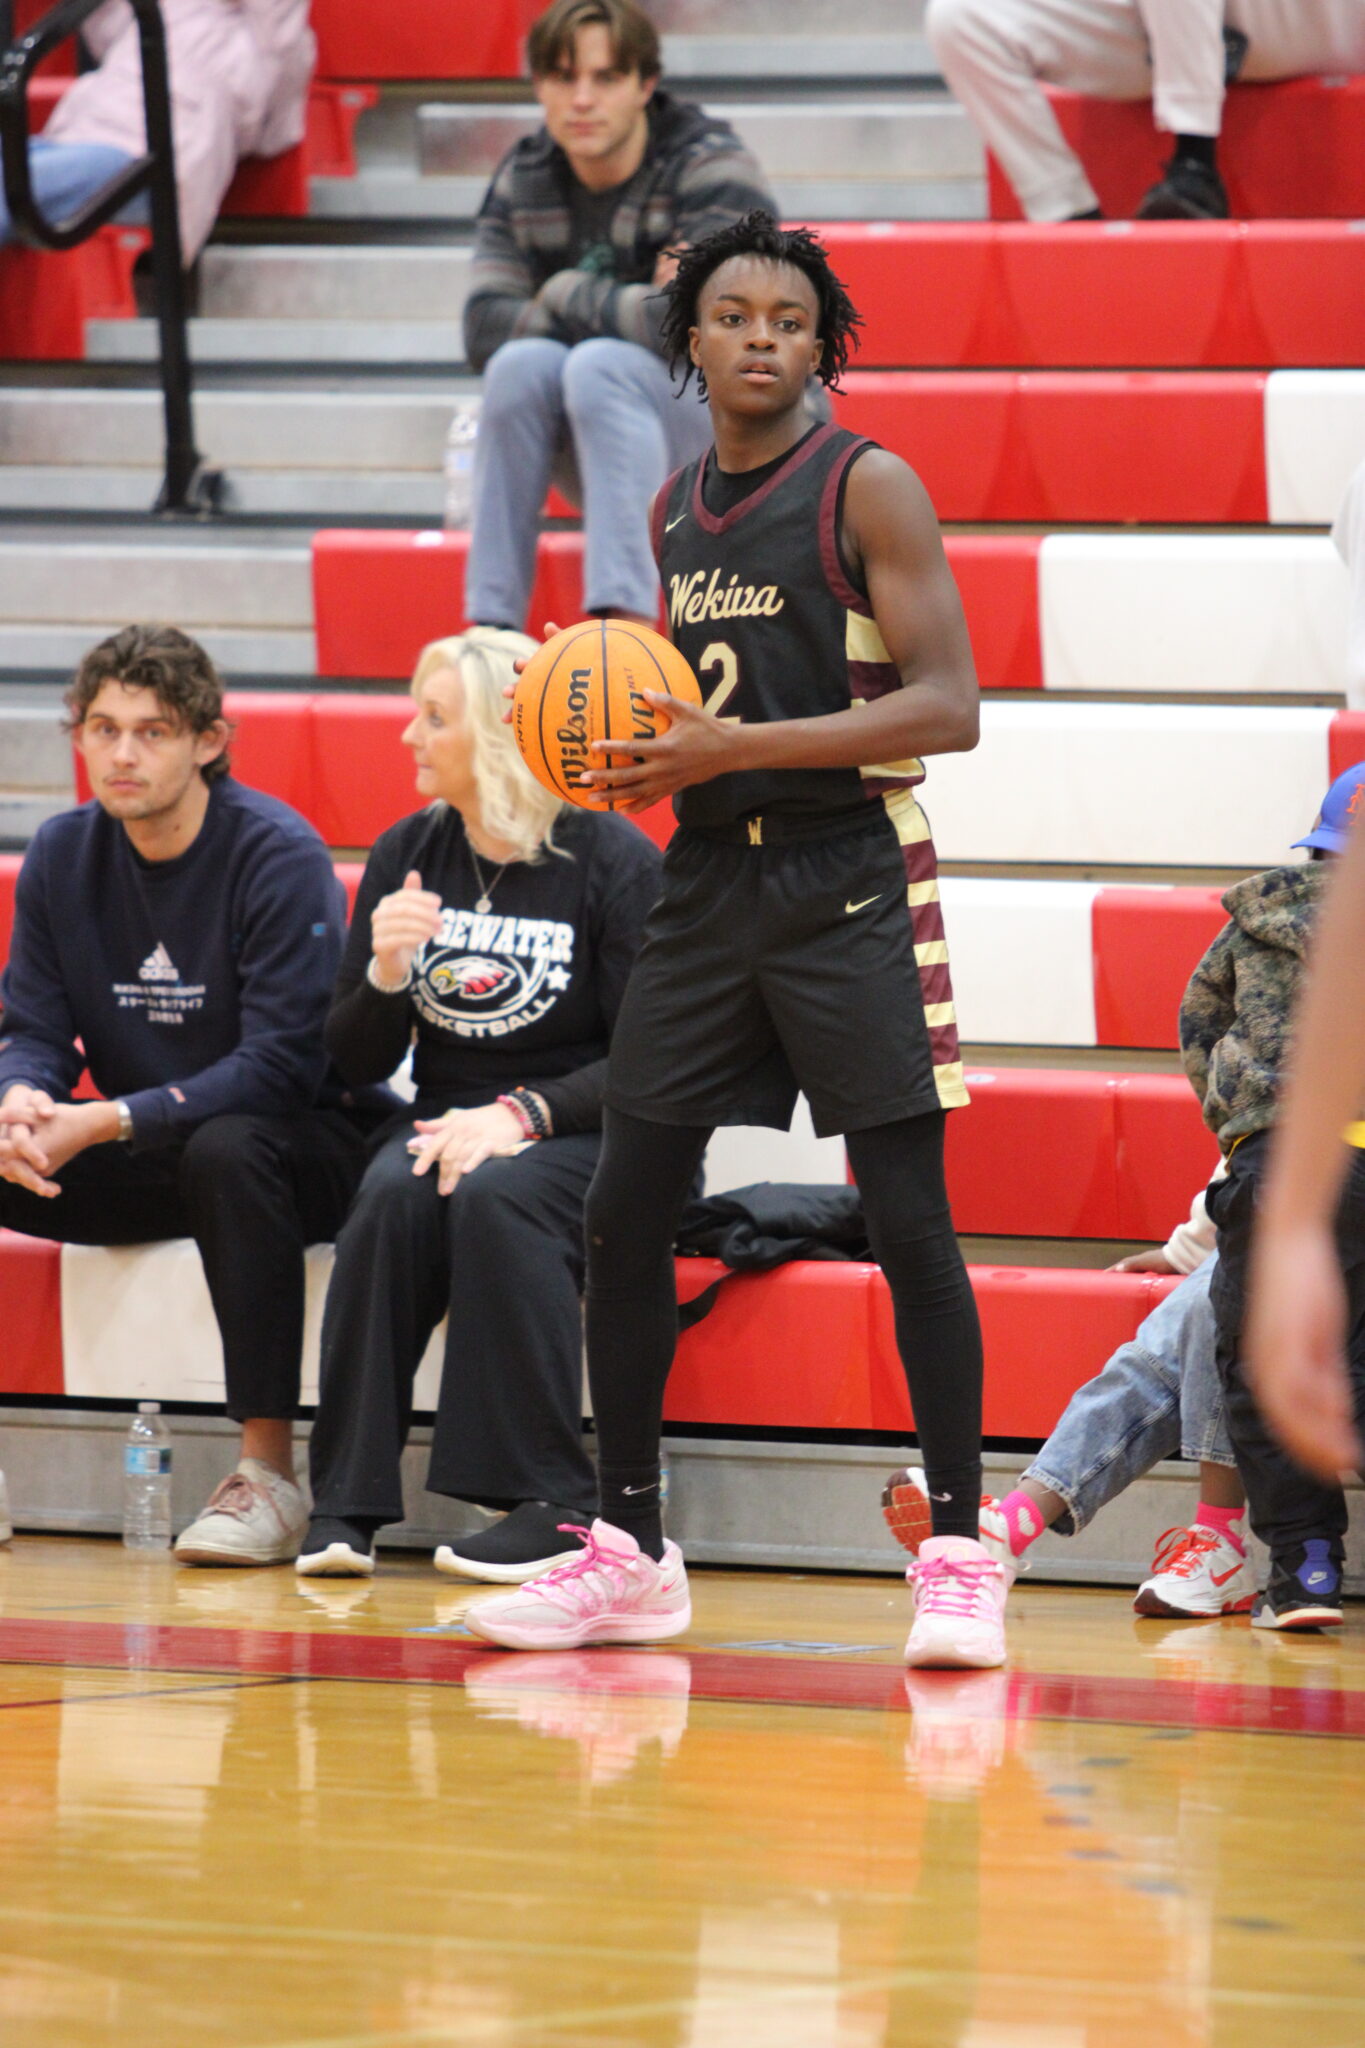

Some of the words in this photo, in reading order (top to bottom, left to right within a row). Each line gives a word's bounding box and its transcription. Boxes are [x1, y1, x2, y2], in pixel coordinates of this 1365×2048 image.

[669, 567, 785, 628] Wekiva
[698, 641, 742, 725] 2
[556, 667, 596, 790] Wilson
[433, 907, 575, 963] GEWATER
